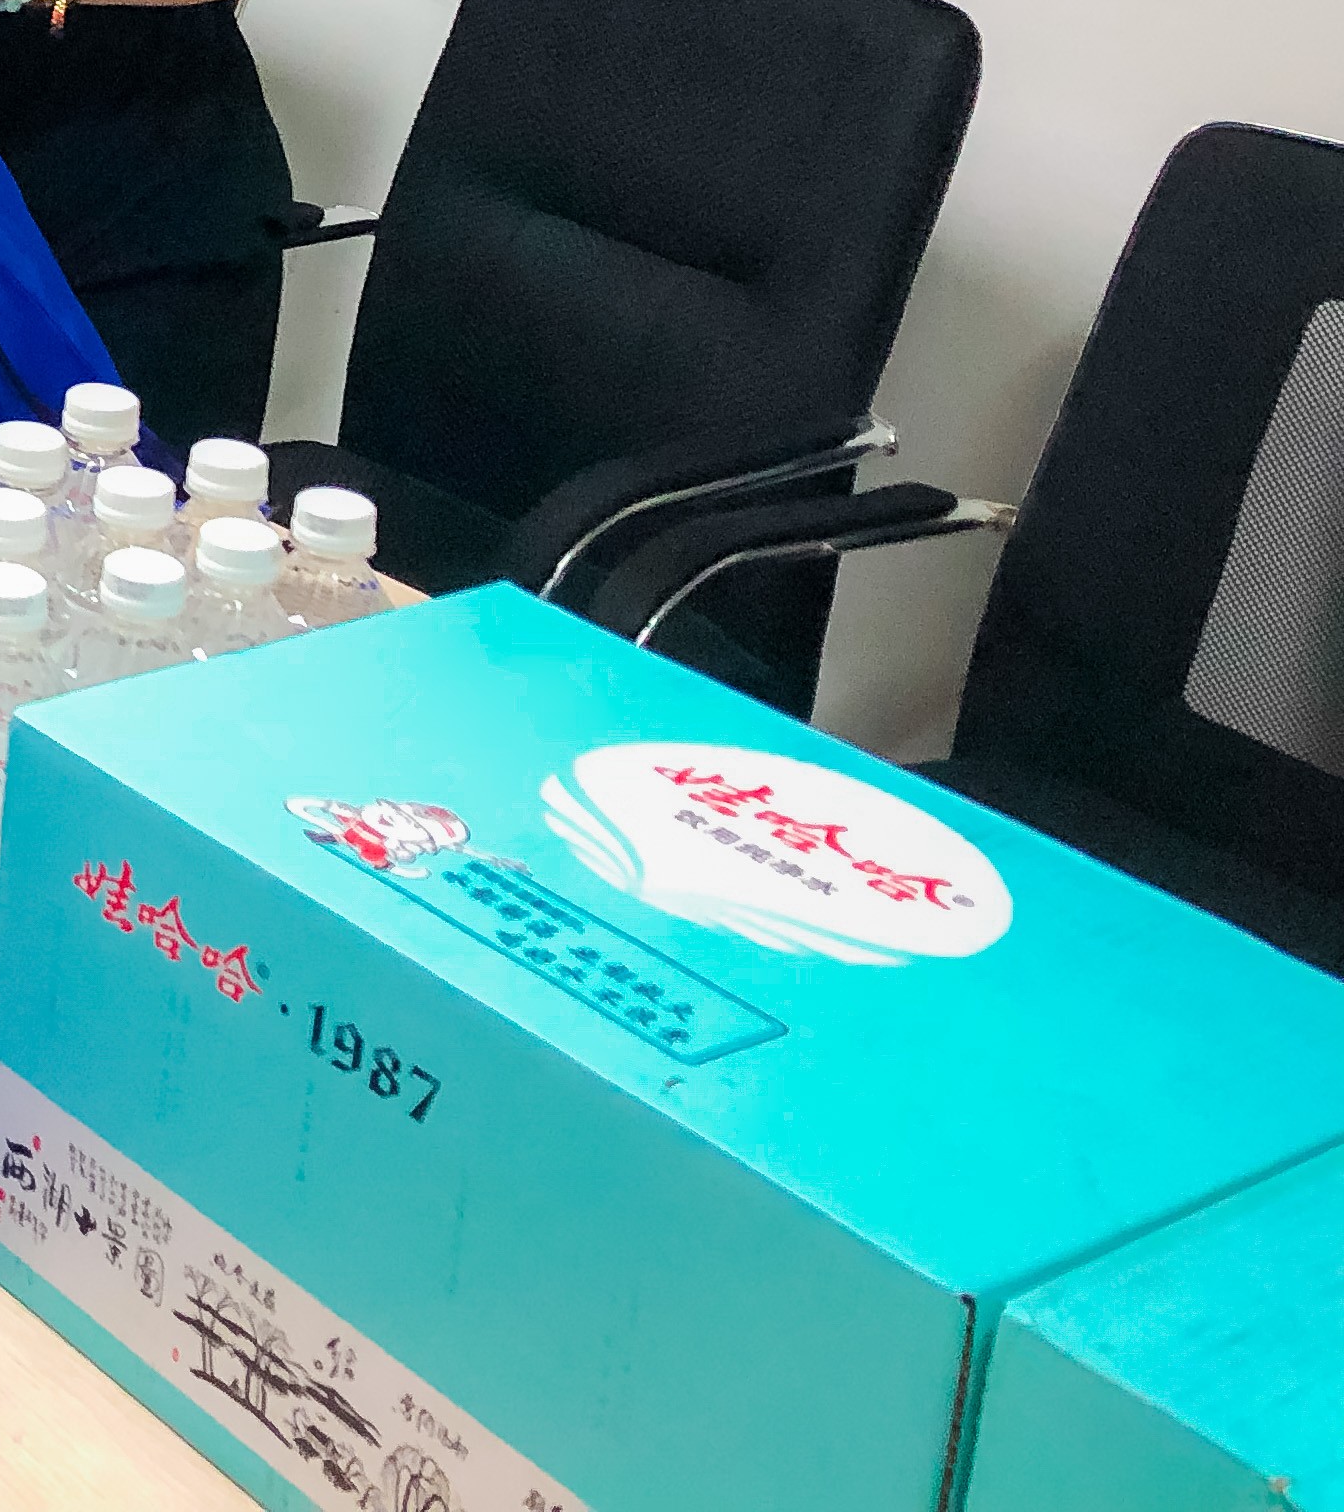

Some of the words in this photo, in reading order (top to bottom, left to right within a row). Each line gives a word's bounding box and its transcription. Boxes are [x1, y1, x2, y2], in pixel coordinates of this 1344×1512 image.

[653, 764, 953, 910] 娃哈哈
[74, 858, 264, 1004] 娃哈哈
